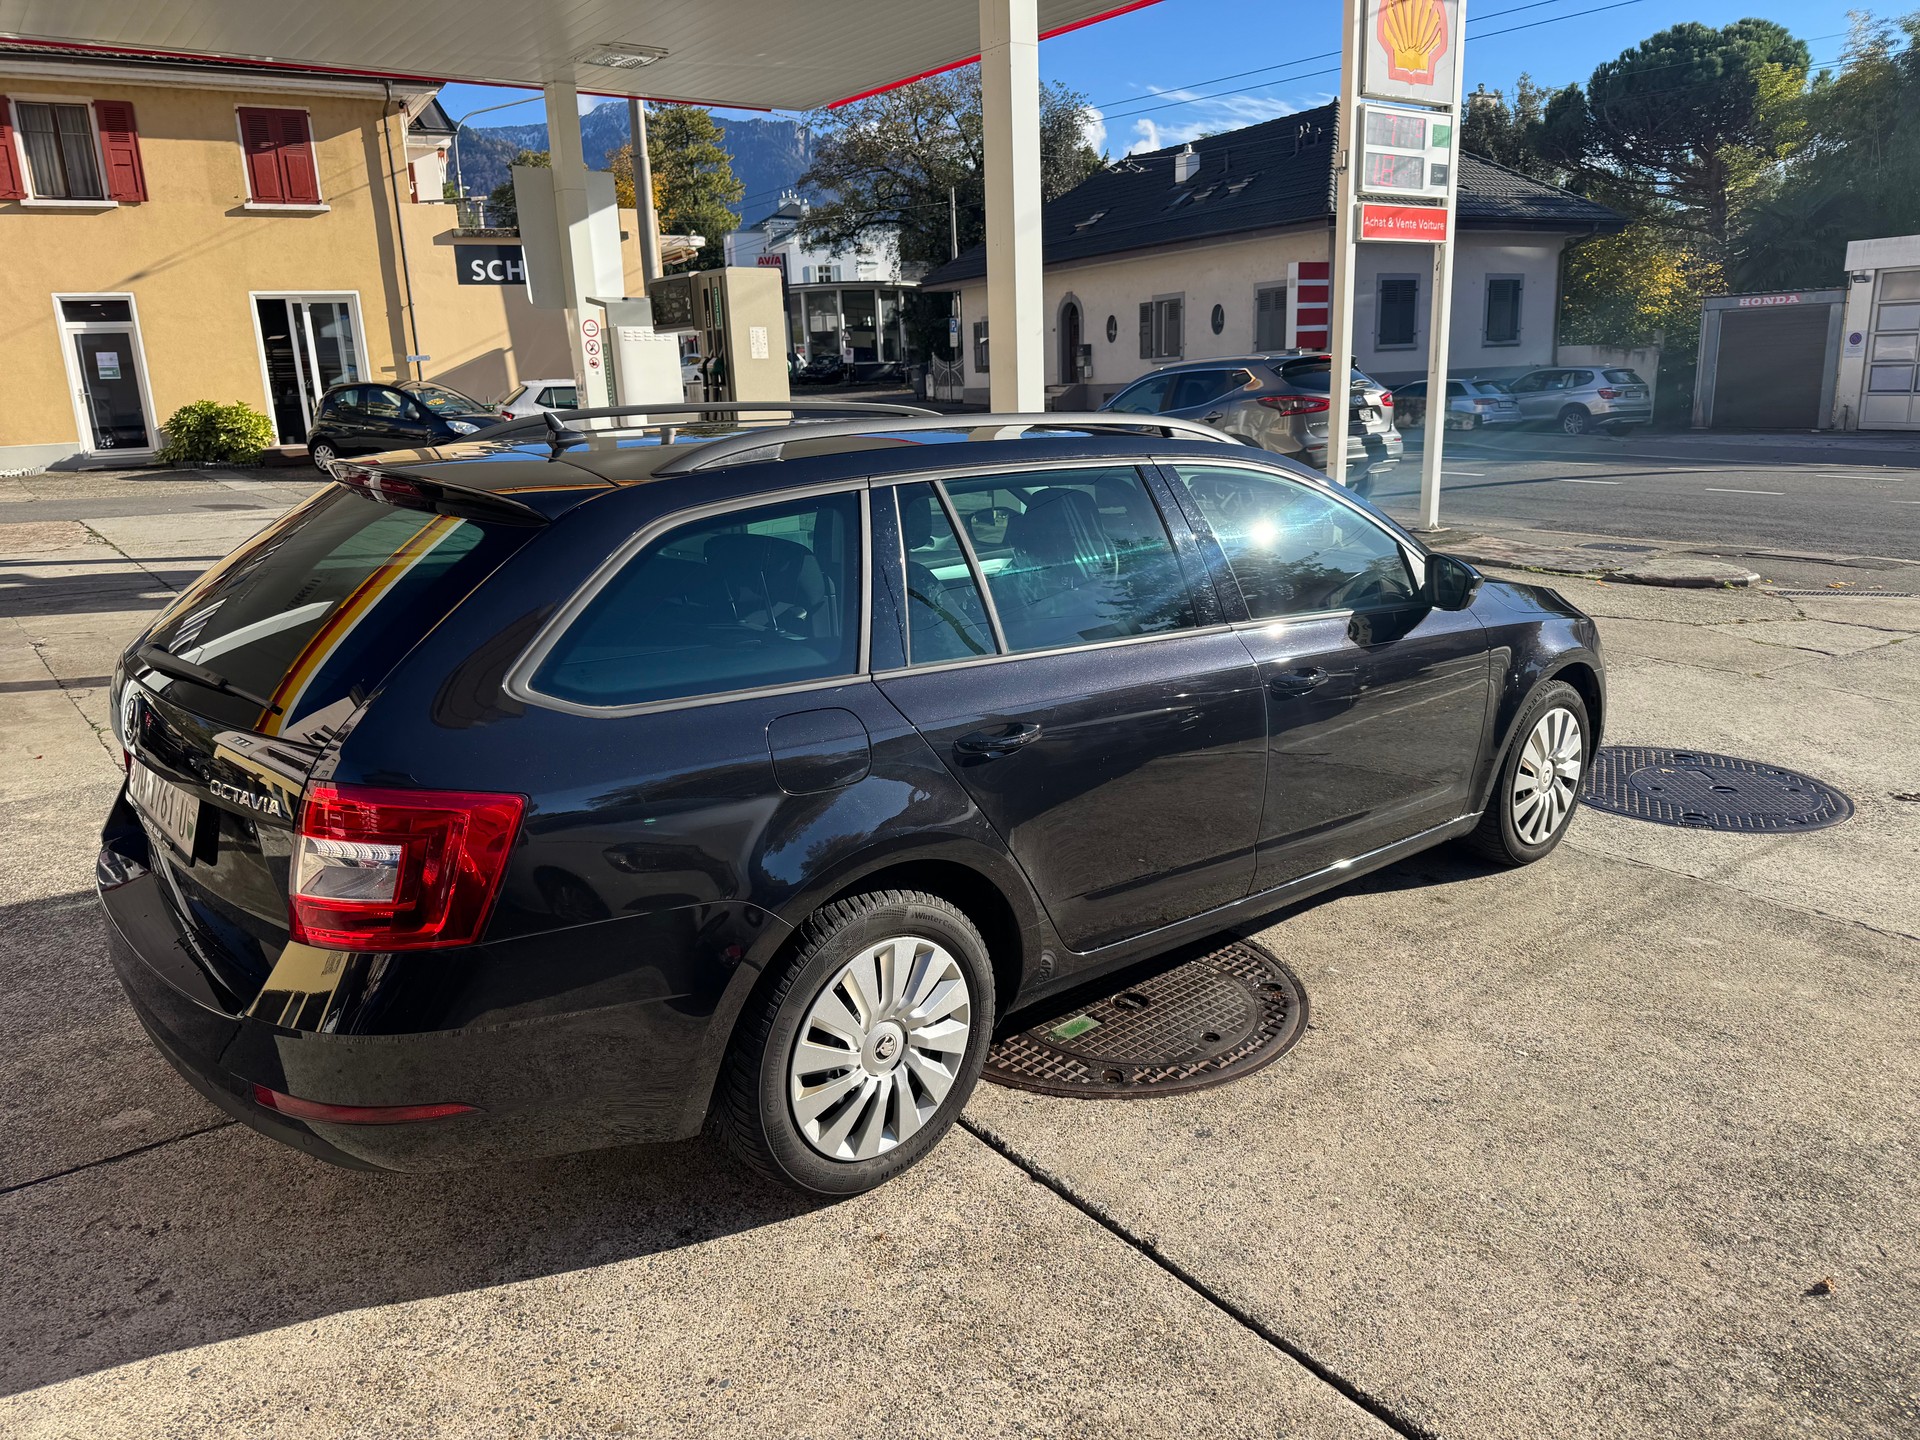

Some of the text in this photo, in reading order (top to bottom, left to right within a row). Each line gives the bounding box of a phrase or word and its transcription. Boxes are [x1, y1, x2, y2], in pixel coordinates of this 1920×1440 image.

[1364, 216, 1445, 231] Achat & Vente Voiture
[757, 256, 782, 265] AVIA
[470, 259, 526, 281] SCH
[1739, 295, 1800, 306] HONDA
[210, 779, 283, 818] OCTAVIA
[915, 1119, 951, 1158] 205/55
